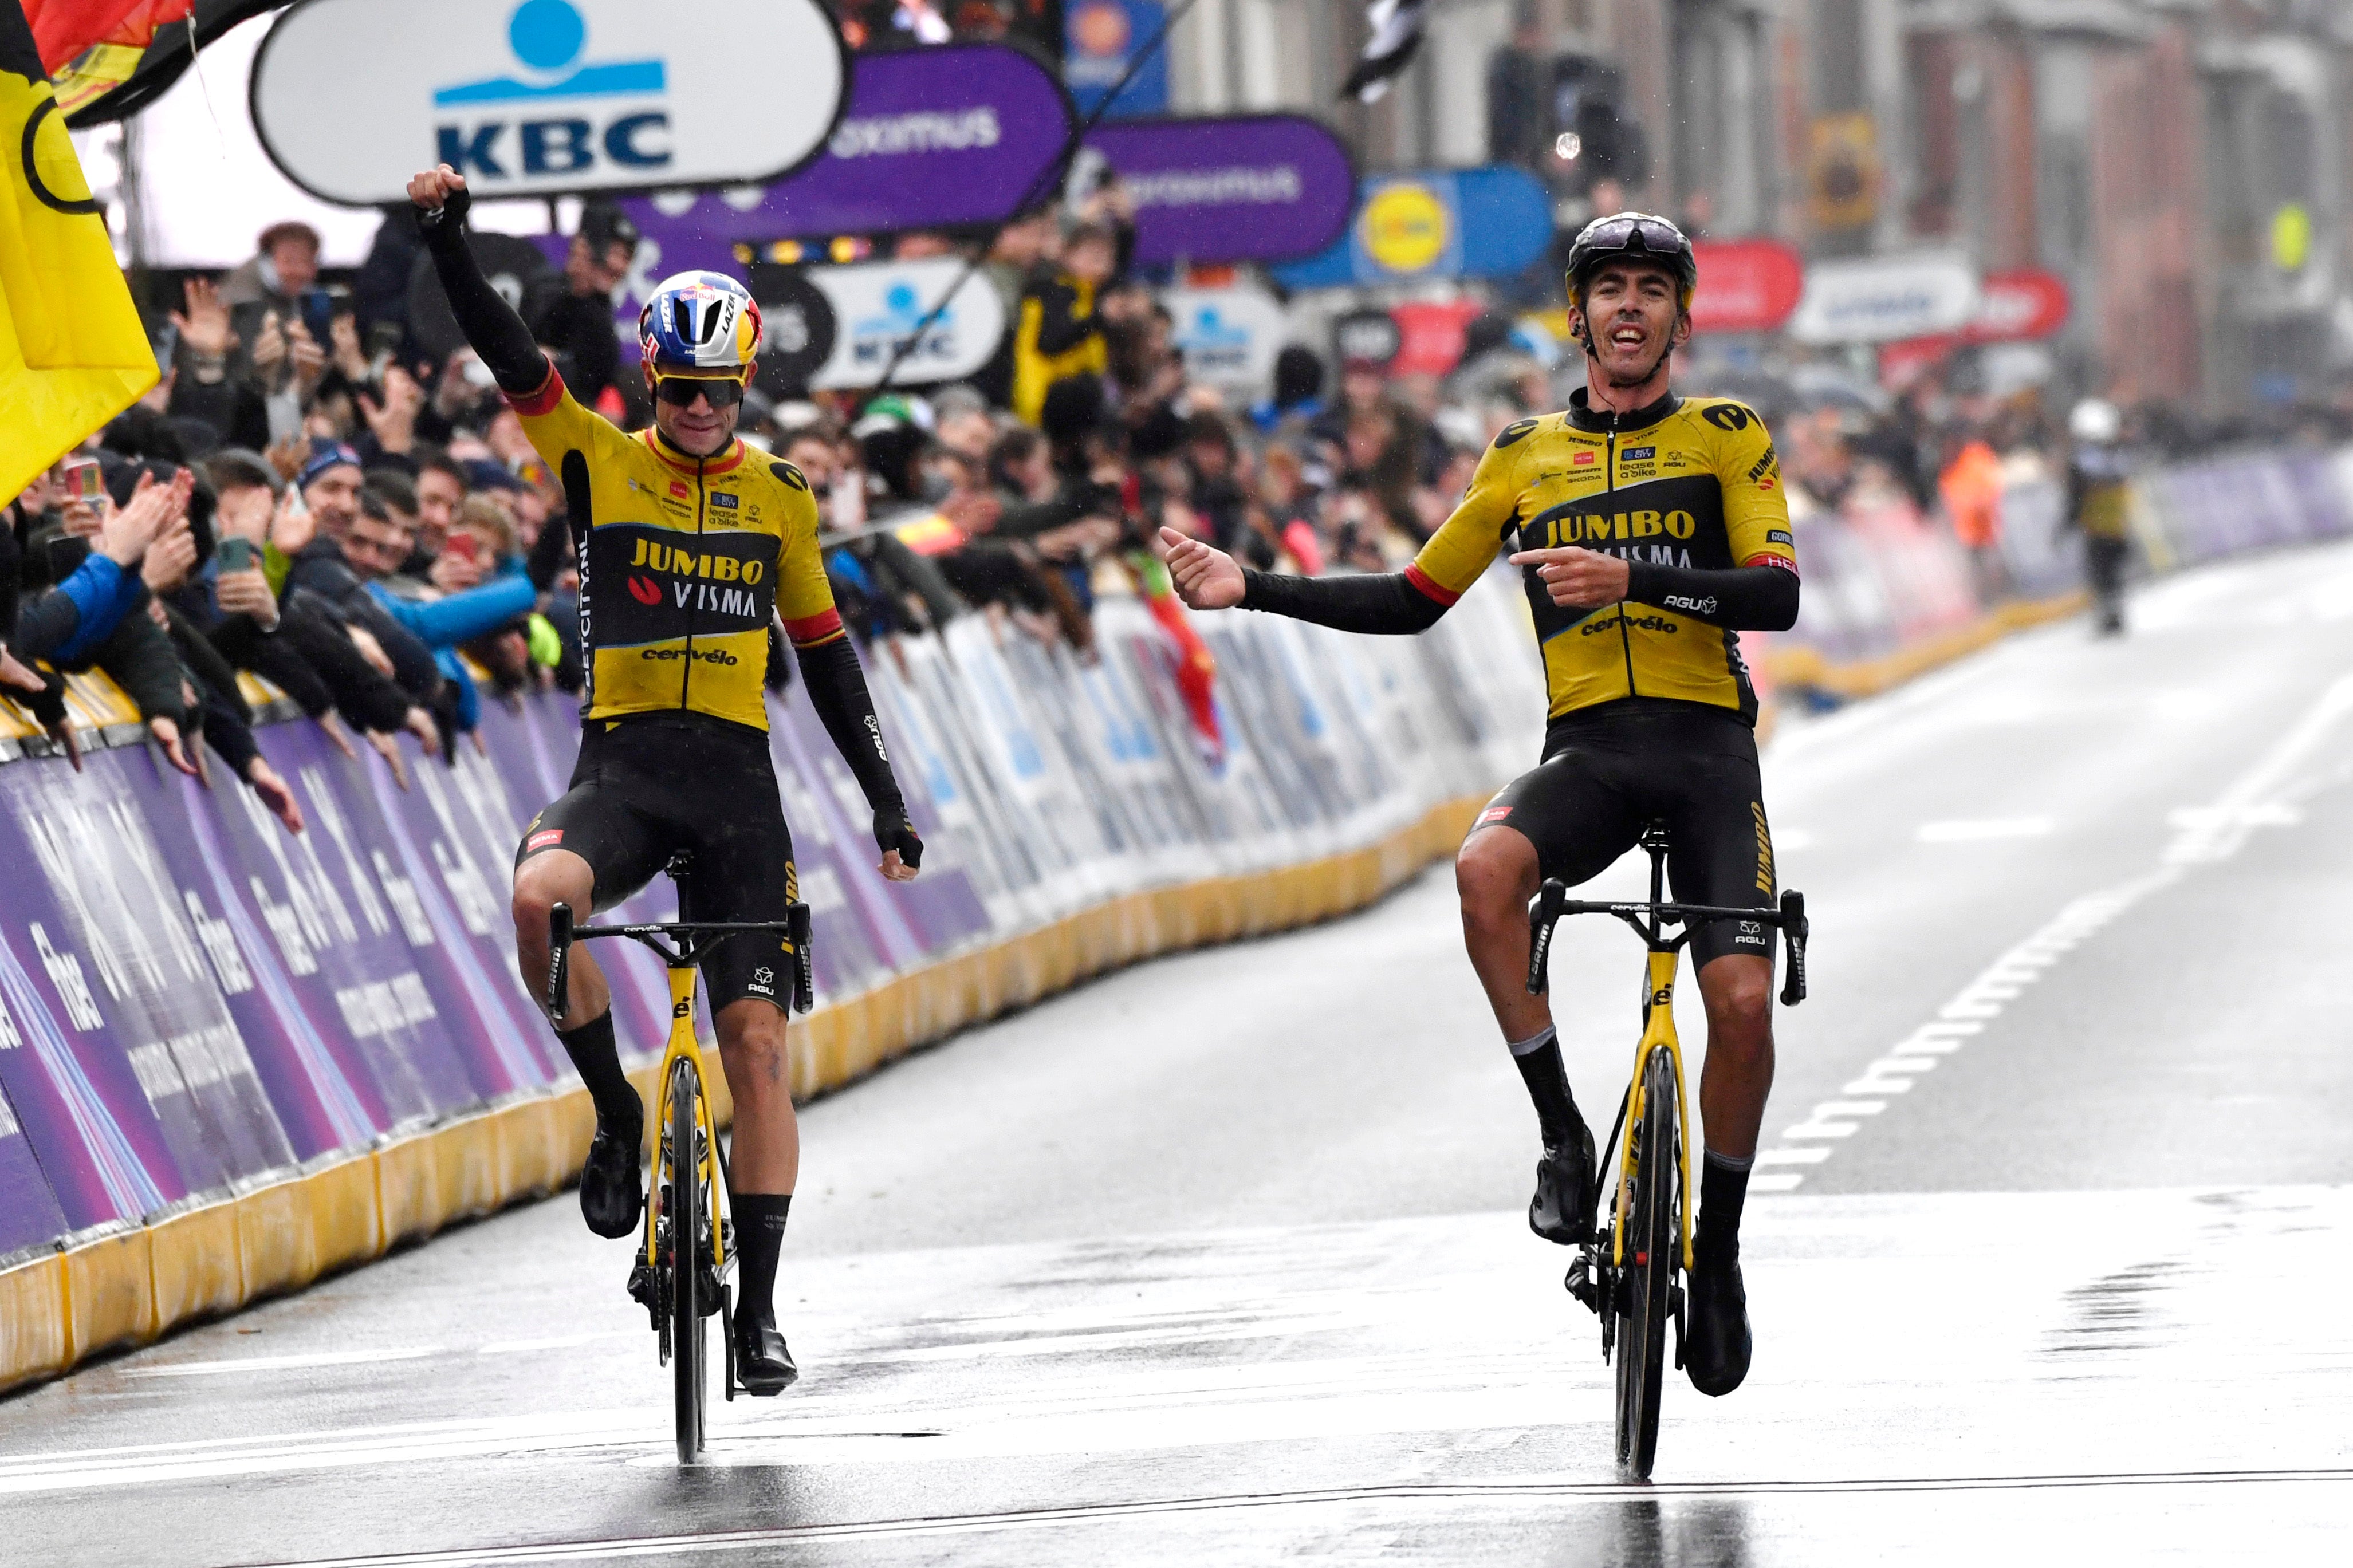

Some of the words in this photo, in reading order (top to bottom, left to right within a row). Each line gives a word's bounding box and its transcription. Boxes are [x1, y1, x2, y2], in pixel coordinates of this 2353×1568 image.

[438, 111, 671, 179] KBC
[660, 294, 673, 333] LAZER
[680, 292, 697, 301] Red
[698, 292, 715, 301] Bull
[722, 294, 736, 335] LAZER
[1568, 436, 1602, 446] JUMBO
[1620, 462, 1655, 471] lease
[709, 507, 738, 519] lease
[745, 516, 762, 525] AGU
[1545, 510, 1696, 549] JUMBO
[630, 538, 764, 586] JUMBO
[579, 530, 591, 688] BETCITY.NL
[673, 581, 756, 618] VISMA
[1663, 594, 1702, 611] AGU
[641, 649, 738, 666] cervélo
[870, 727, 888, 762] AGU
[528, 834, 558, 847] HEMA
[1750, 801, 1772, 901] JUMBO
[1530, 923, 1550, 975] SRAM
[1735, 936, 1766, 945] AGU
[548, 946, 562, 995] SRAM
[747, 983, 774, 996] AGU
